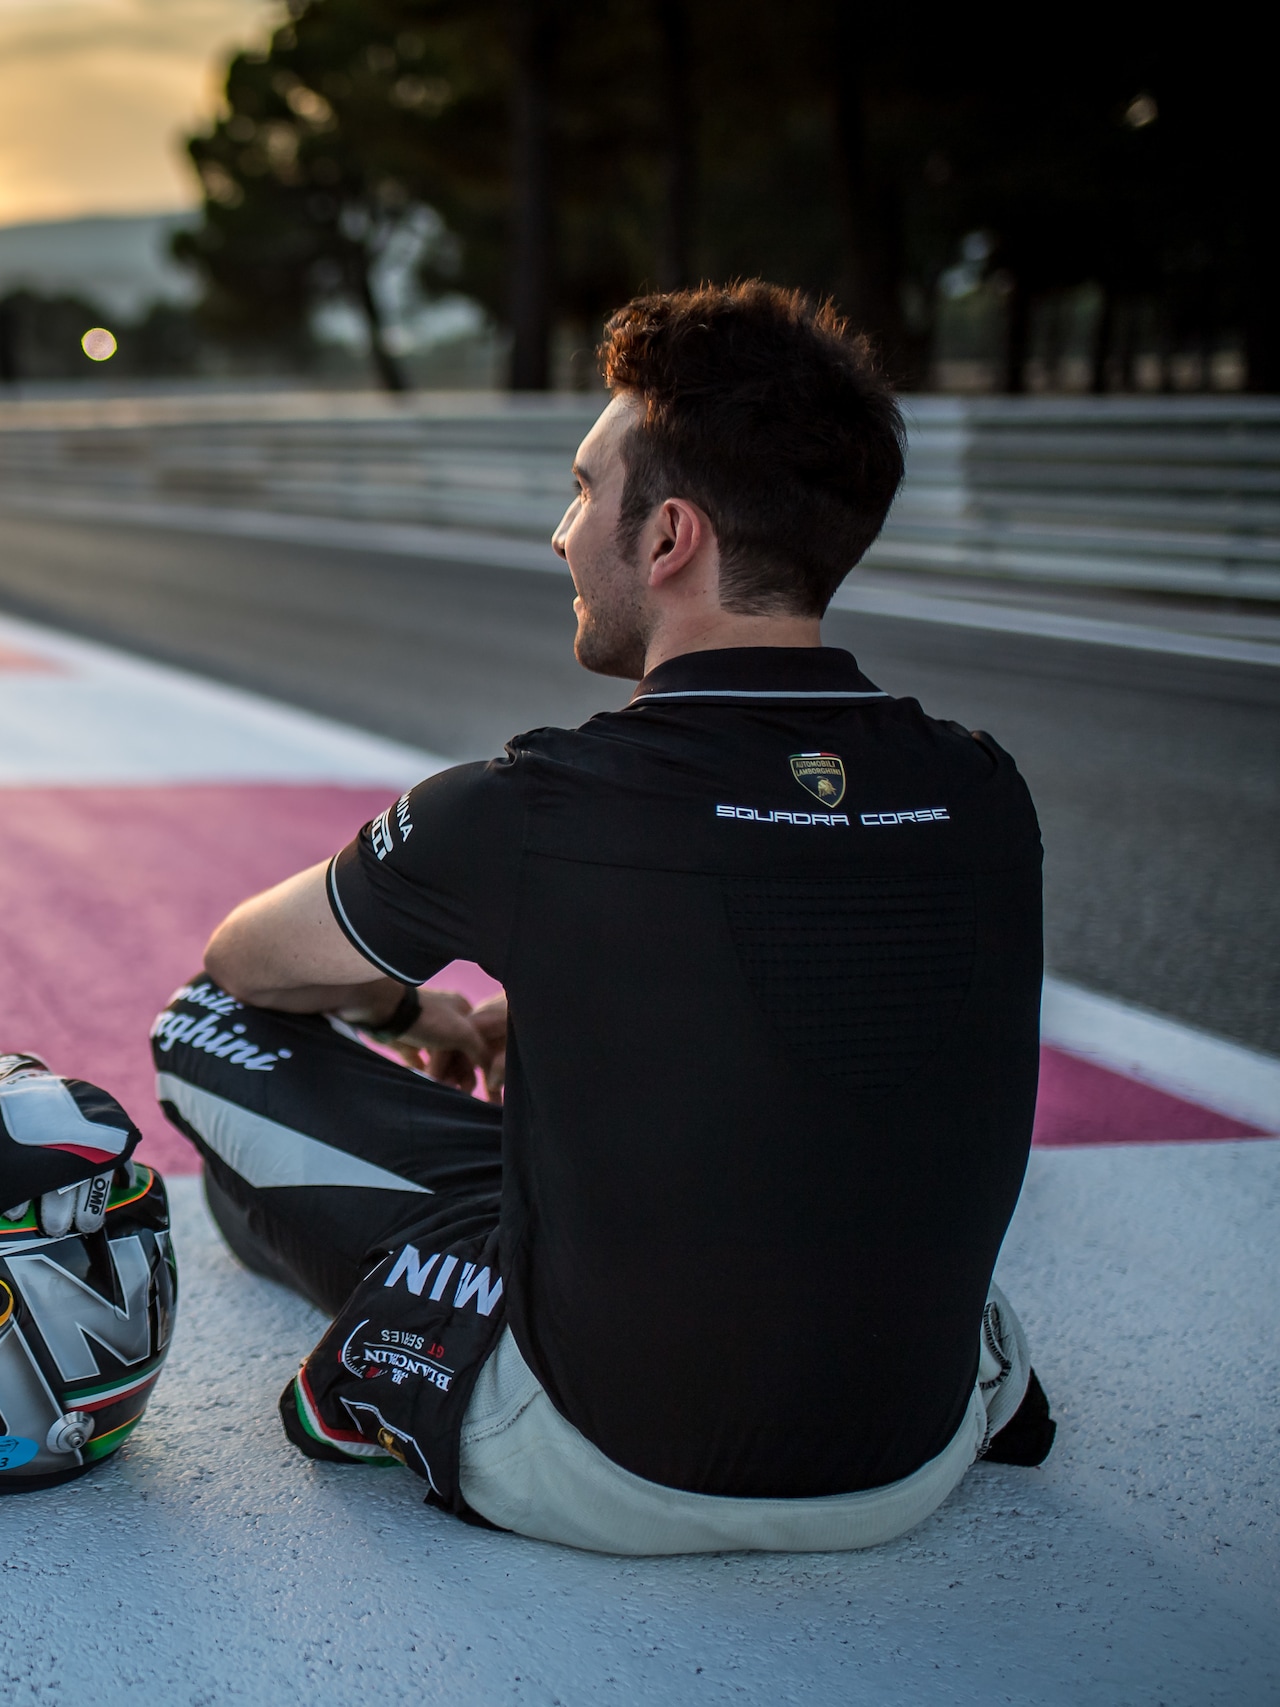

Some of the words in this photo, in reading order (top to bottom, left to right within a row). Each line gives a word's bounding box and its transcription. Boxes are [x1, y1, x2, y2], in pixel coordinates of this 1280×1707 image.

[795, 760, 836, 768] AUTOMOBILI
[795, 768, 841, 777] LAMBORGHINI
[716, 805, 850, 827] SQUADRA
[860, 808, 950, 826] CORSE
[89, 1178, 106, 1215] OMP
[383, 1243, 504, 1317] MIN
[381, 1330, 425, 1350] SERIES
[427, 1343, 445, 1358] GT
